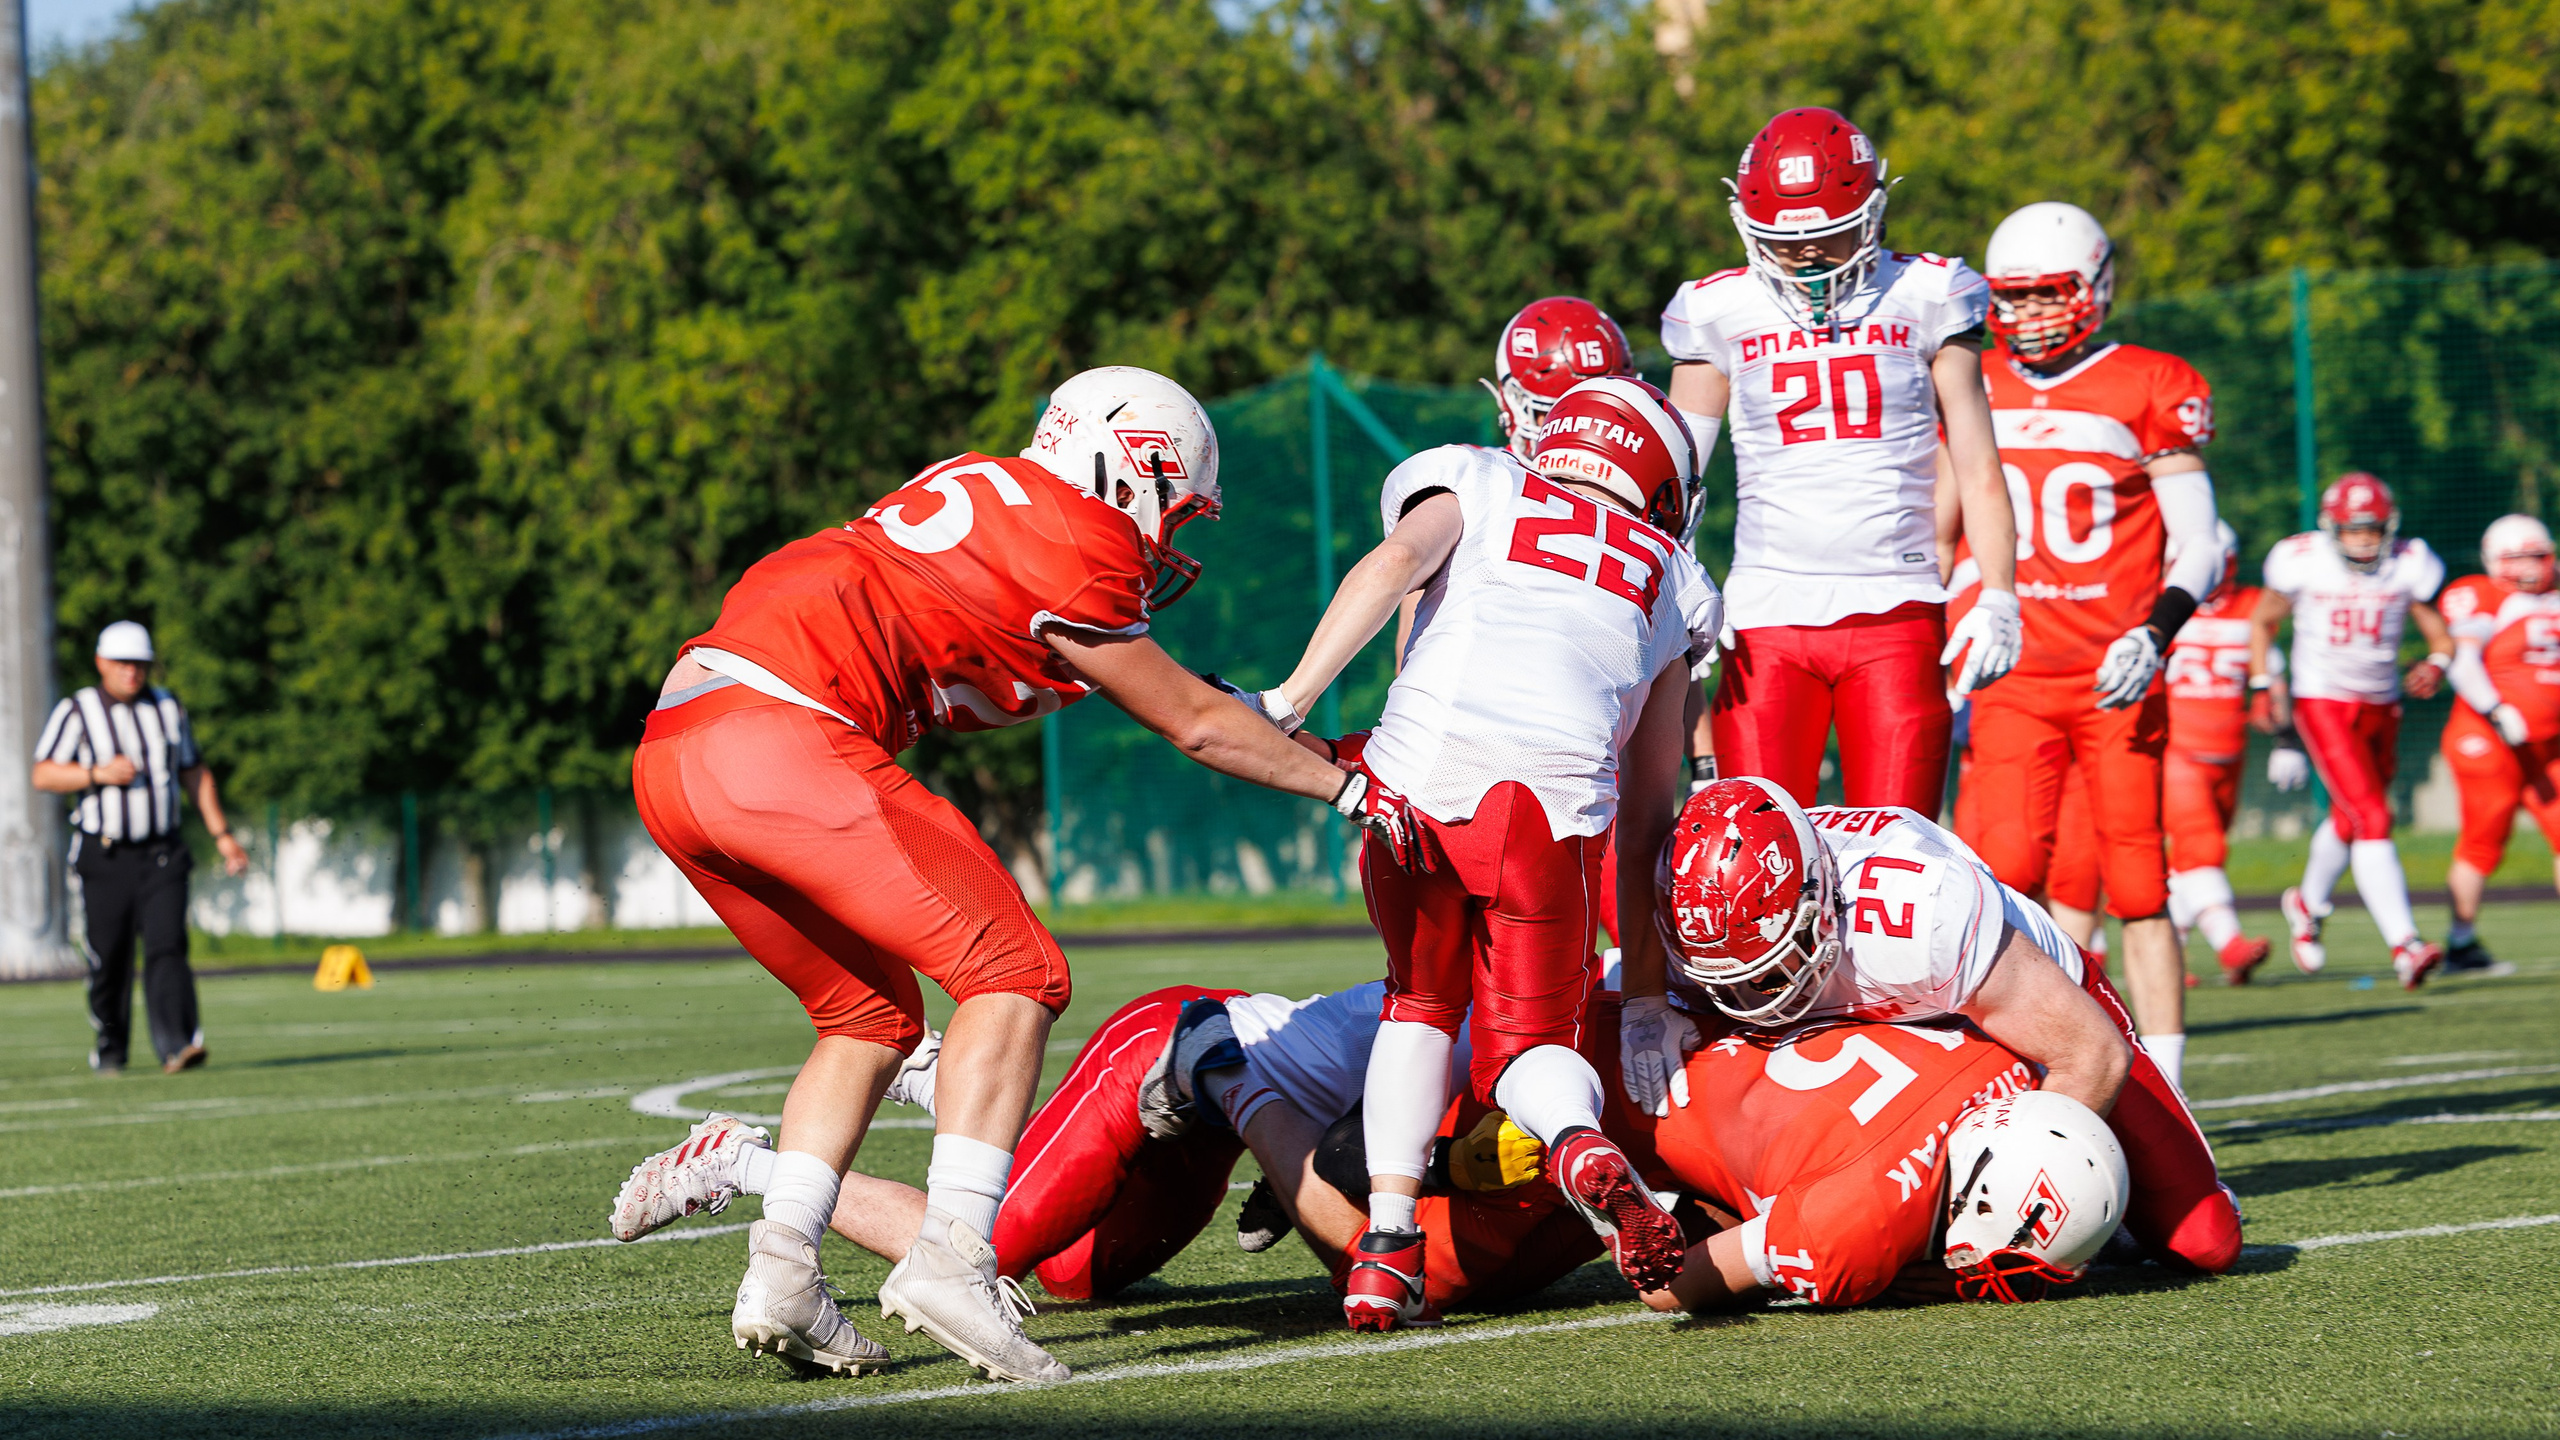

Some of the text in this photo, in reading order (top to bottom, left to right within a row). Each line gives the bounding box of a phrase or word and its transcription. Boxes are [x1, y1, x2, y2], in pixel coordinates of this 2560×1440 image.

[1779, 156, 1814, 185] 20
[1575, 341, 1604, 367] 15
[1772, 355, 1882, 446] 20
[1538, 454, 1613, 481] Riddell
[863, 452, 1033, 554] 5
[1507, 472, 1675, 627] 25
[2330, 609, 2383, 646] 94
[1807, 811, 1904, 836] AGAL
[1855, 856, 1926, 939] 27
[1677, 907, 1715, 936] 27
